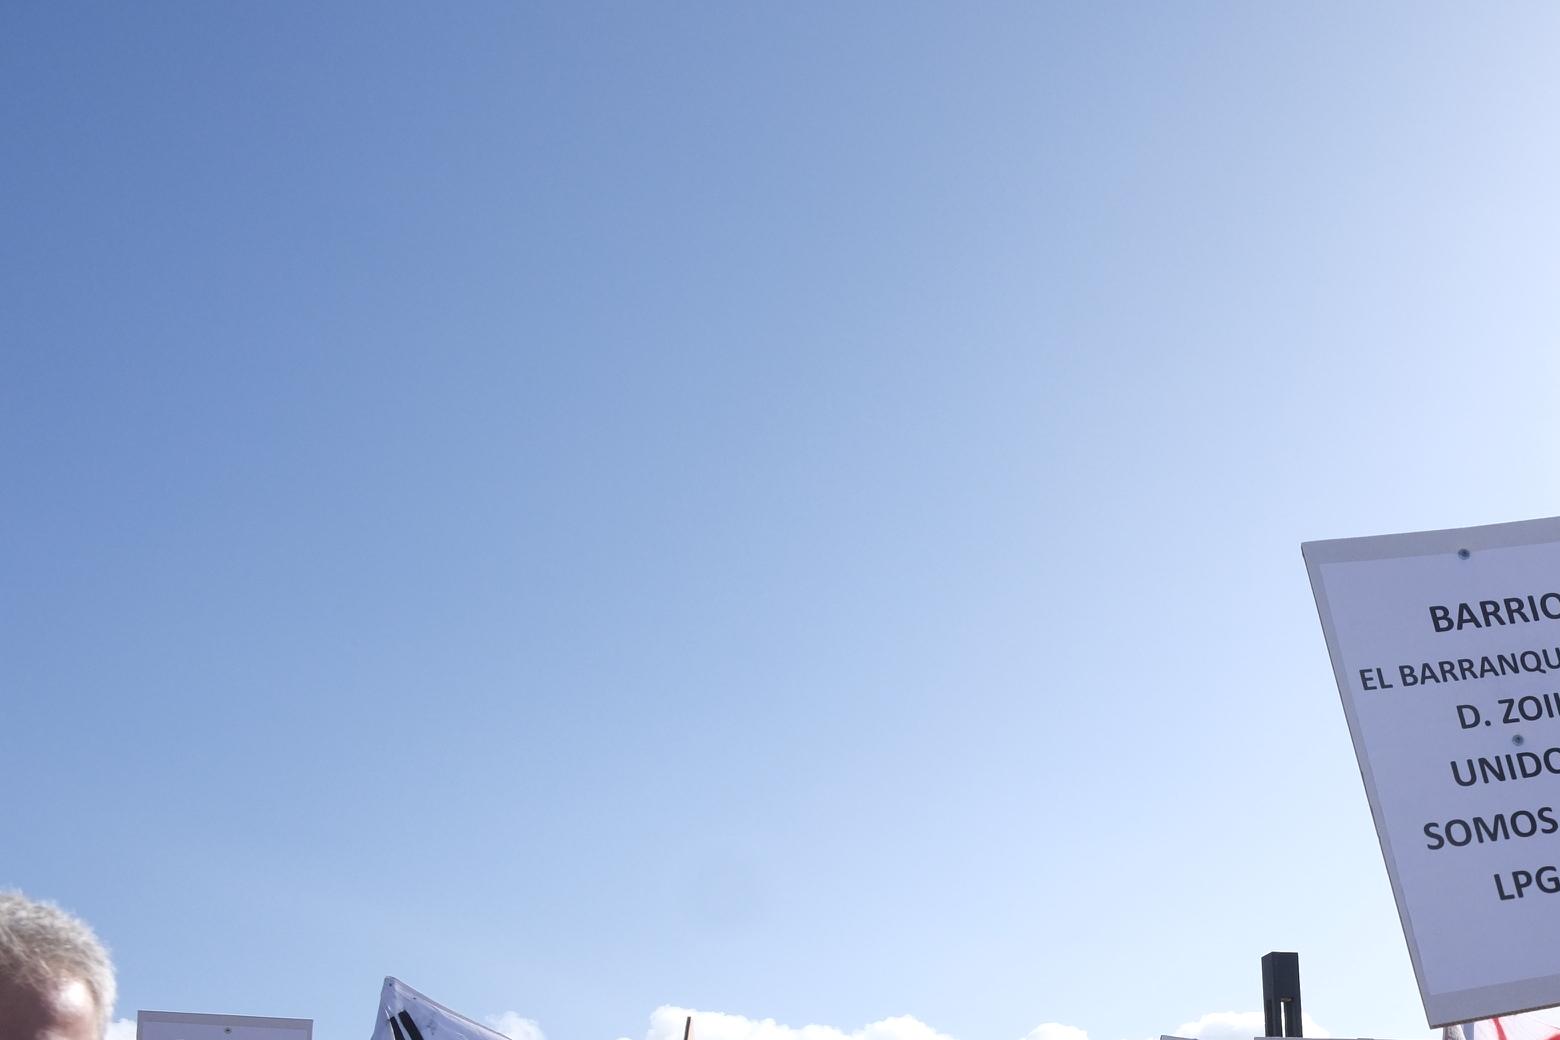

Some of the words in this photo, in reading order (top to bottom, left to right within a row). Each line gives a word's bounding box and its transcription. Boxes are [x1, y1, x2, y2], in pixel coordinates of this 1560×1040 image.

[1358, 667, 1394, 691] EL
[1456, 704, 1492, 730] D.
[1423, 806, 1559, 851] SOMOS
